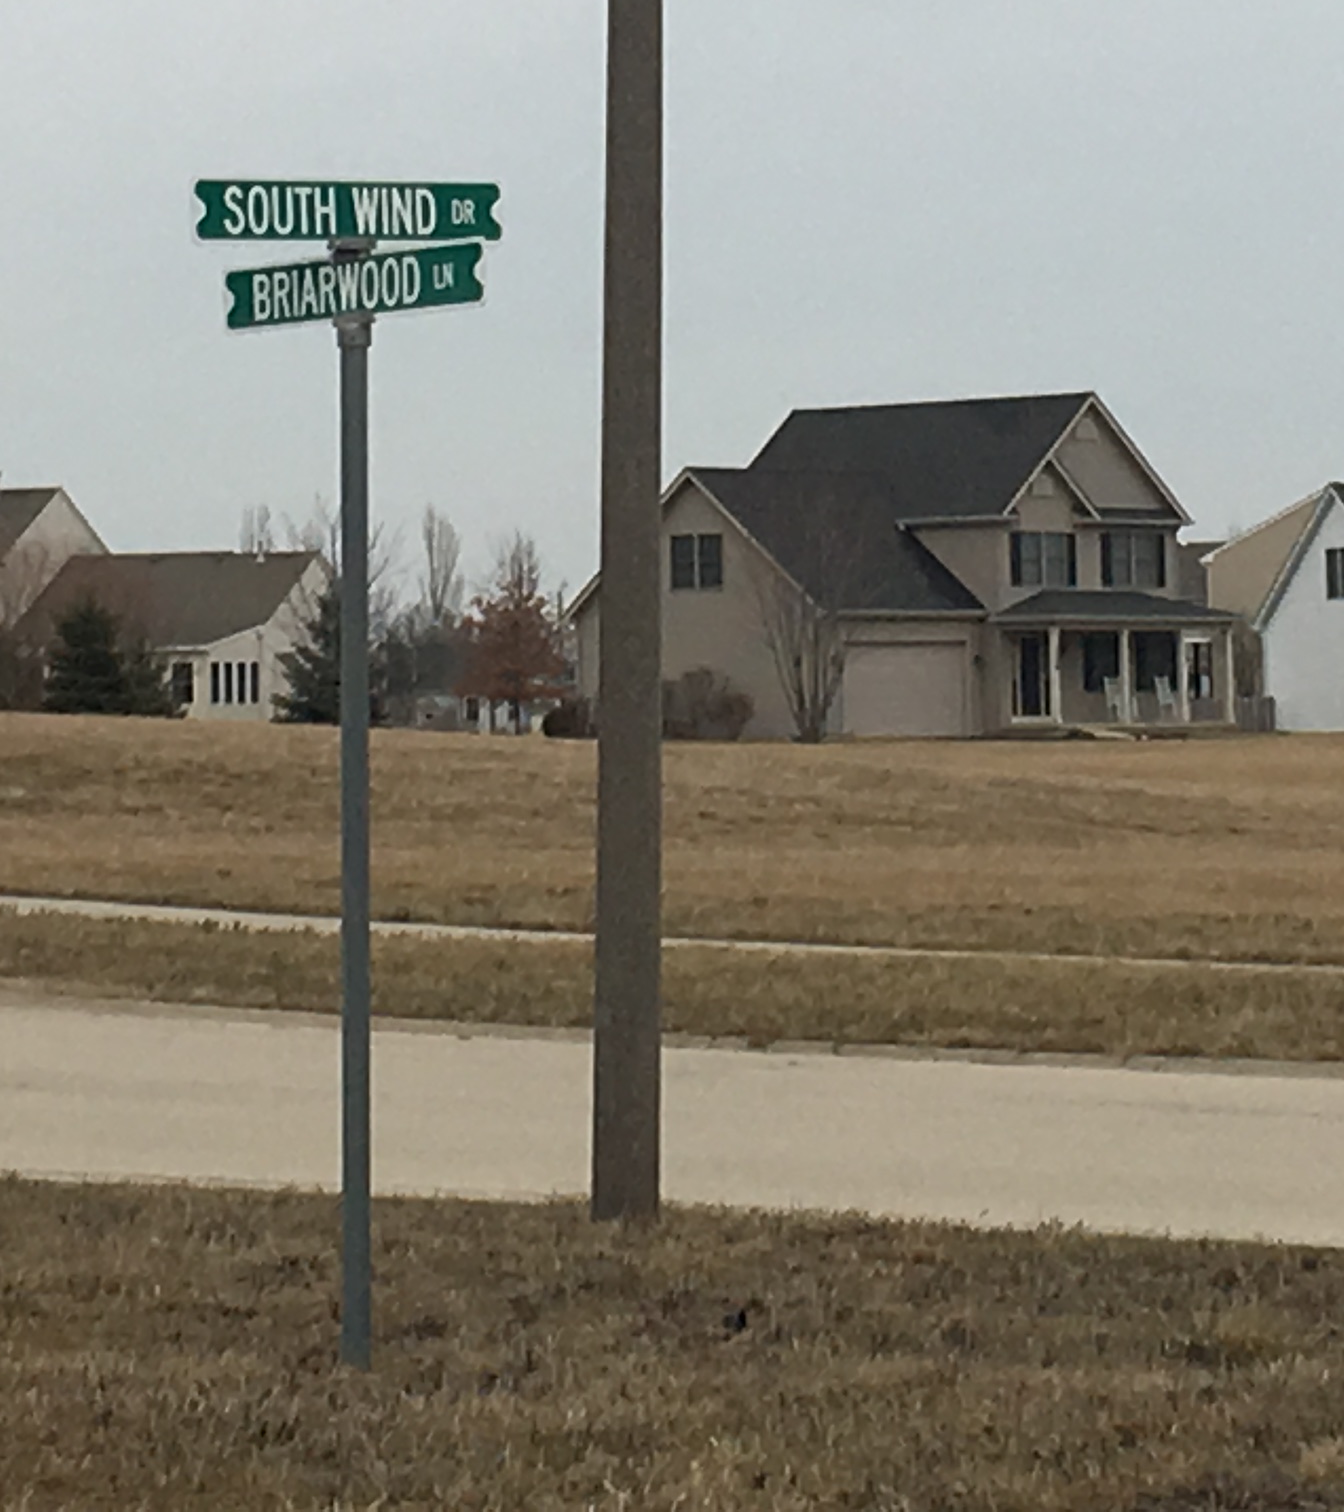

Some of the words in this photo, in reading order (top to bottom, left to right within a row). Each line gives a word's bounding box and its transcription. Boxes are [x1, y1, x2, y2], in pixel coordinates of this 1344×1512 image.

[223, 185, 336, 235] SOUTH
[352, 187, 437, 235] WIND
[451, 199, 476, 225] DR
[252, 256, 421, 321] BRIARWOOD
[432, 262, 454, 290] LN
